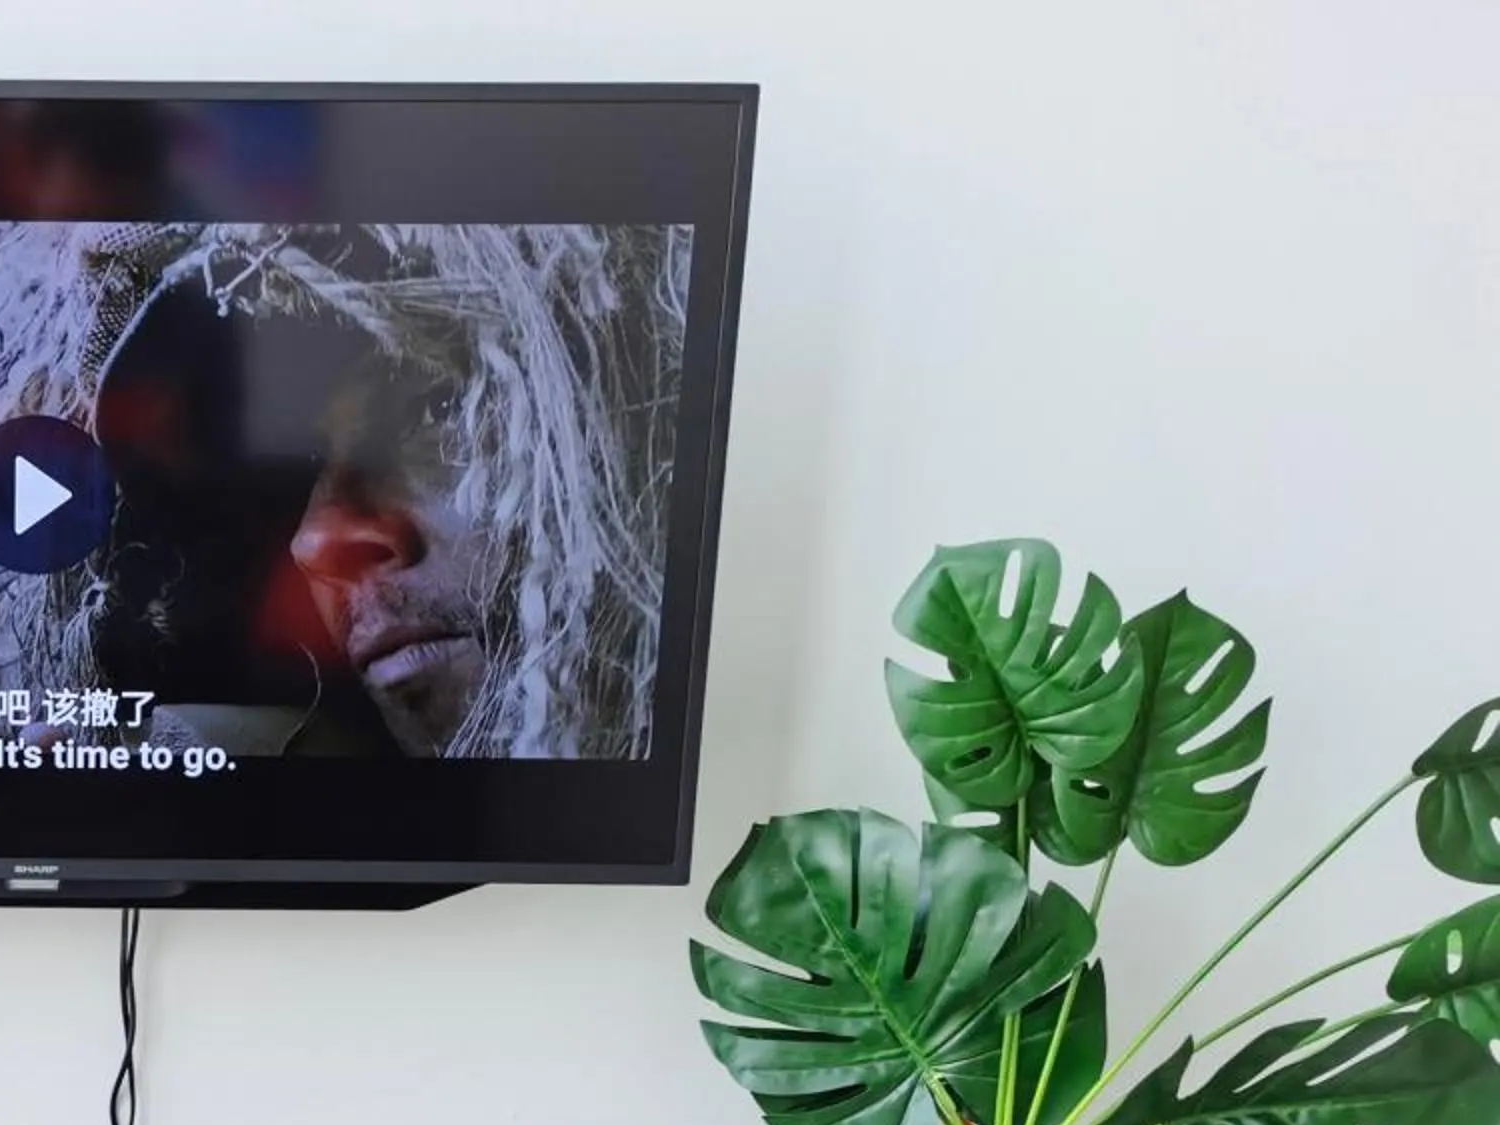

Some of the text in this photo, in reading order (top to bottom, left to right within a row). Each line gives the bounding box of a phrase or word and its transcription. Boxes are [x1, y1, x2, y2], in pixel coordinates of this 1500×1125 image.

[41, 687, 155, 726] 该撤了
[51, 737, 131, 769] time
[138, 740, 173, 770] to
[182, 745, 237, 777] go.
[13, 864, 59, 874] SHARP
